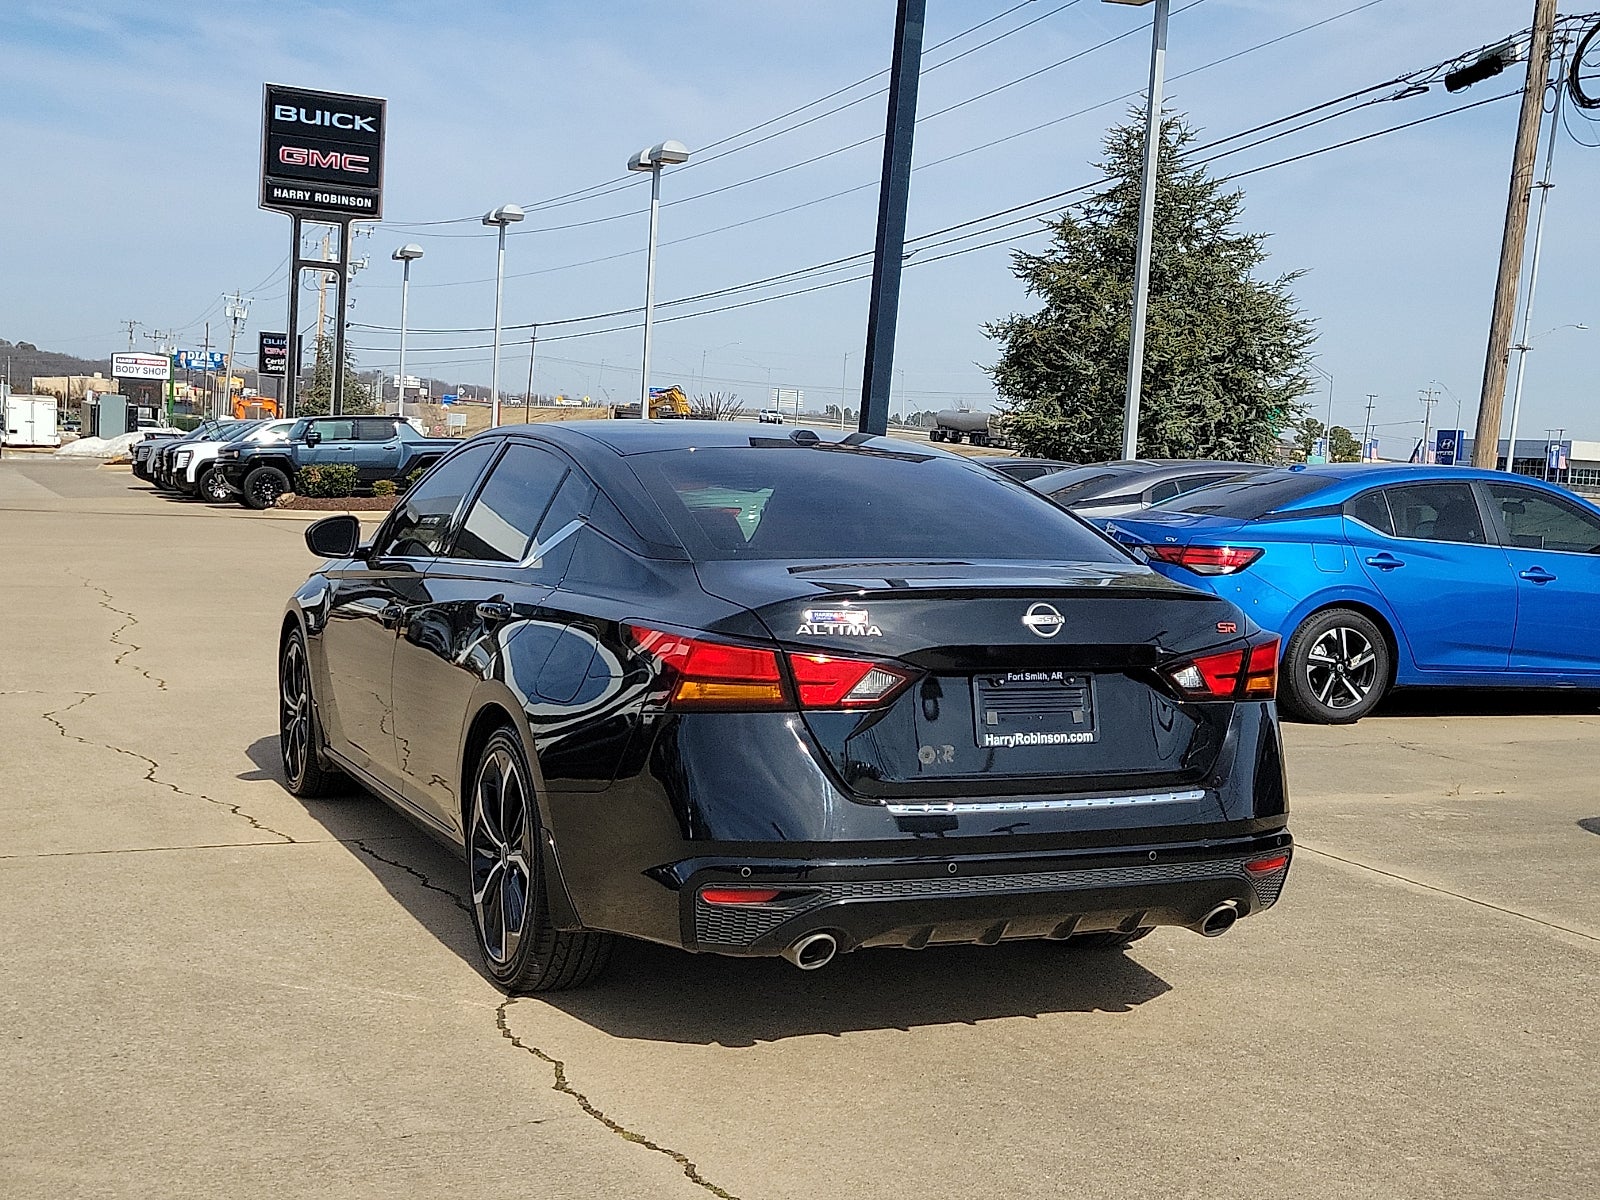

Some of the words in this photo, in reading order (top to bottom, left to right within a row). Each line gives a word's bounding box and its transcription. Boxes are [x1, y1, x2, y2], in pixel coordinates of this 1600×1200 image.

[274, 104, 377, 133] BUICK
[279, 145, 370, 173] GMC
[273, 188, 311, 201] HARRY
[314, 192, 372, 208] ROBINSON
[187, 351, 213, 361] DIAL
[213, 353, 222, 362] 8
[115, 365, 141, 374] BODY
[142, 366, 167, 376] SHOP
[795, 623, 883, 637] ALTIMA
[1217, 622, 1237, 633] SR
[1007, 672, 1024, 680] Fort
[1025, 672, 1050, 681] Smith,
[1051, 671, 1063, 680] AR
[985, 732, 1094, 748] HarryRobinson.com
